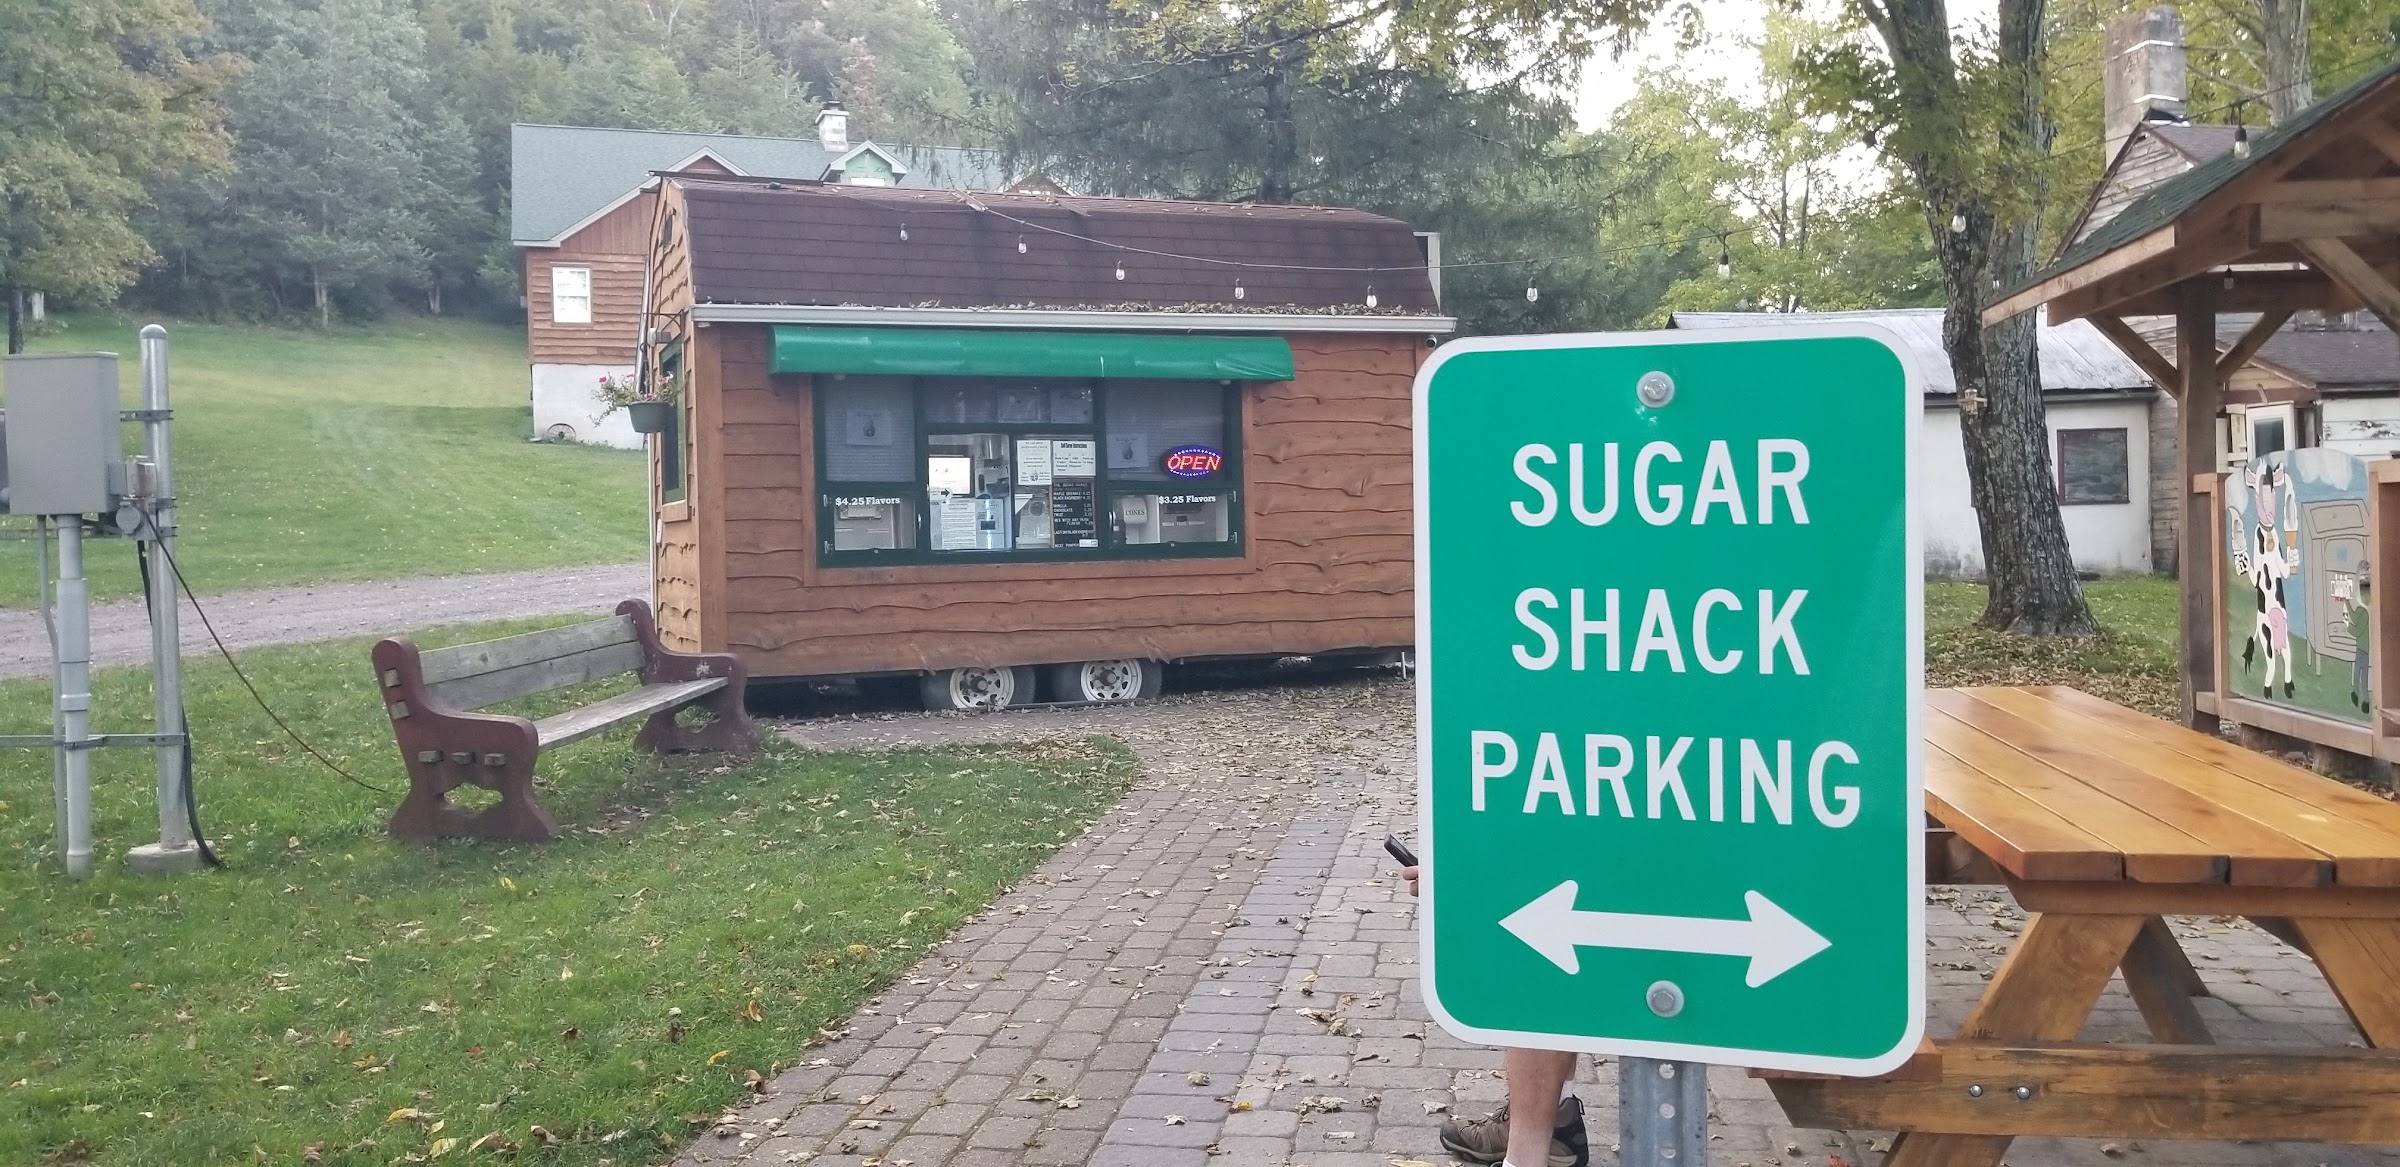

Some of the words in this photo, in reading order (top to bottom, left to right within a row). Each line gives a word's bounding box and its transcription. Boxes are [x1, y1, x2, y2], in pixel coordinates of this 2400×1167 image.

[1167, 455, 1221, 470] OPEN
[1511, 439, 1809, 526] SUGAR
[835, 496, 865, 506] $4.25
[865, 496, 900, 505] Flavors
[1158, 495, 1184, 504] $3.25
[1186, 494, 1216, 503] Flavors
[1512, 588, 1809, 674] SHACK
[1472, 731, 1860, 827] PARKING
